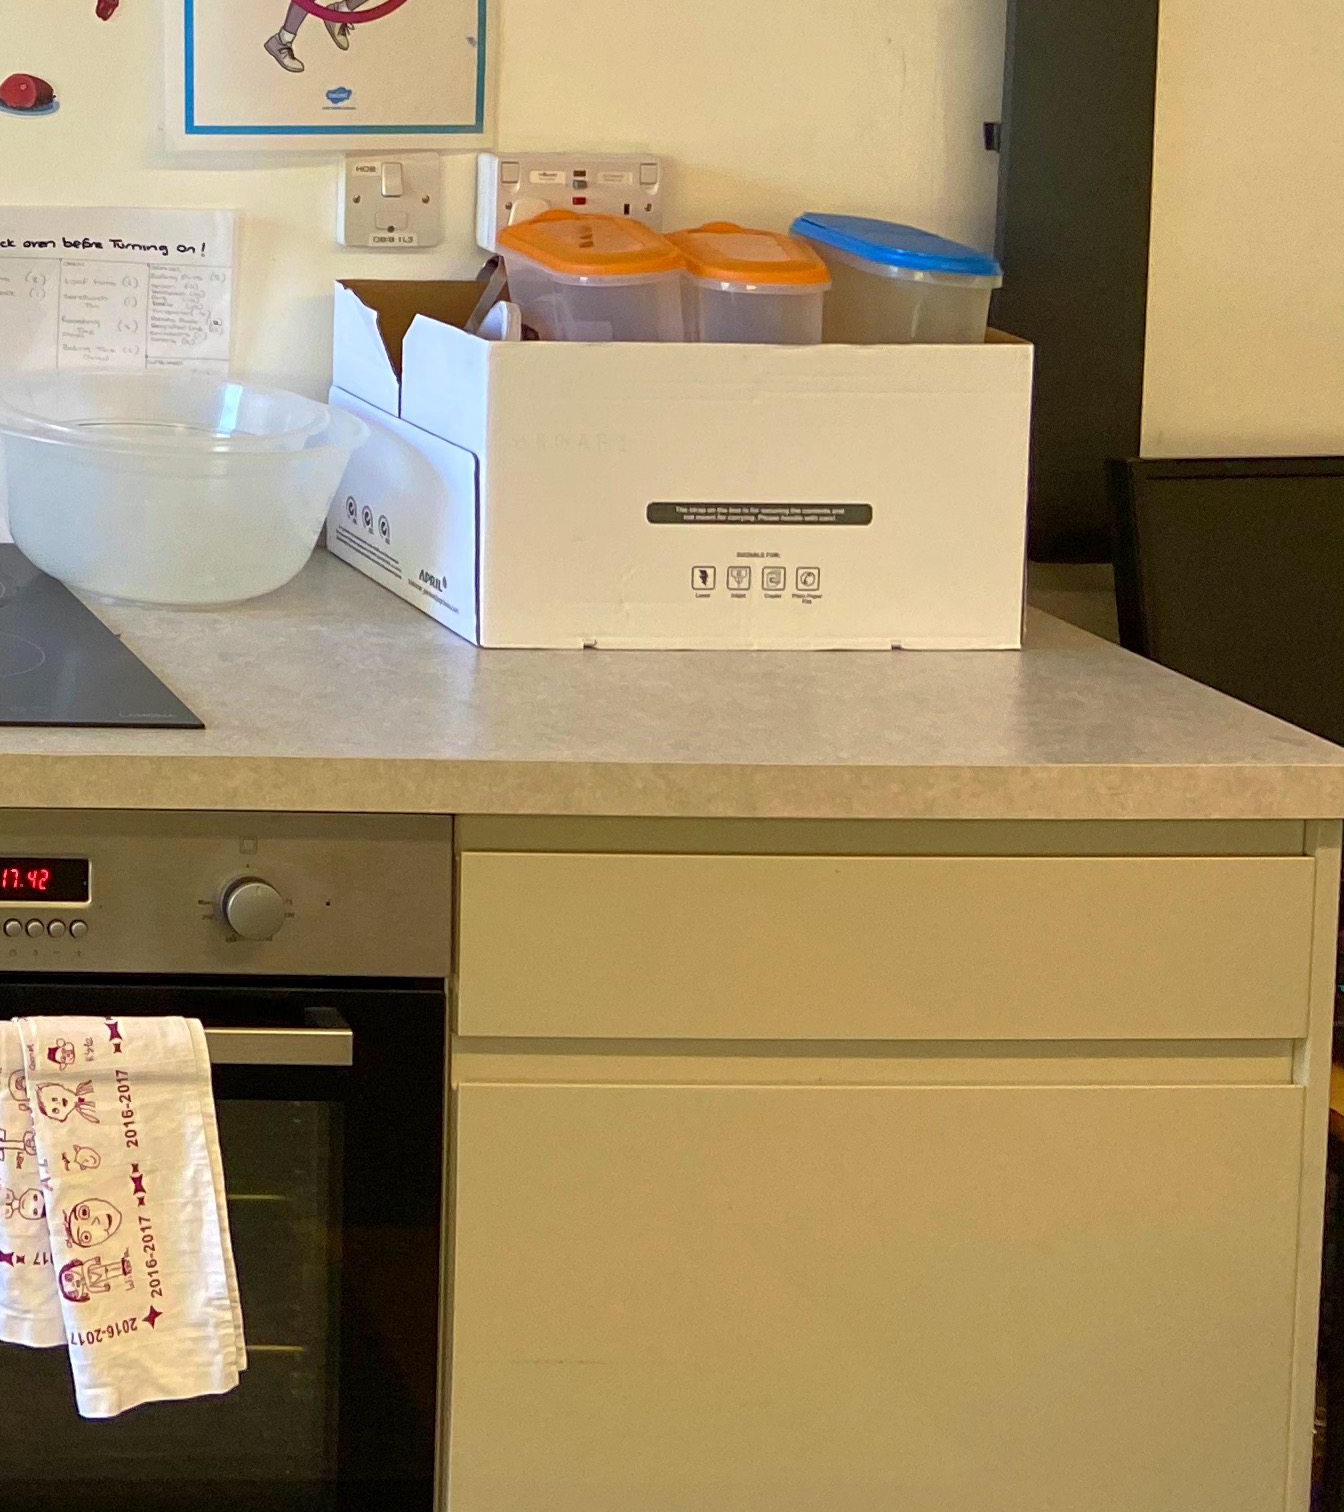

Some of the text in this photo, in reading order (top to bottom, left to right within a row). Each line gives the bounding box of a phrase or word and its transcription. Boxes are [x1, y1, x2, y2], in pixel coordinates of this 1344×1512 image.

[23, 240, 56, 248] oven
[109, 239, 169, 255] Turning
[419, 569, 443, 592] APRIL
[115, 1070, 140, 1148] 2016-2017
[138, 1216, 163, 1298] 2016-2017
[70, 1317, 138, 1346] 2016-2017
